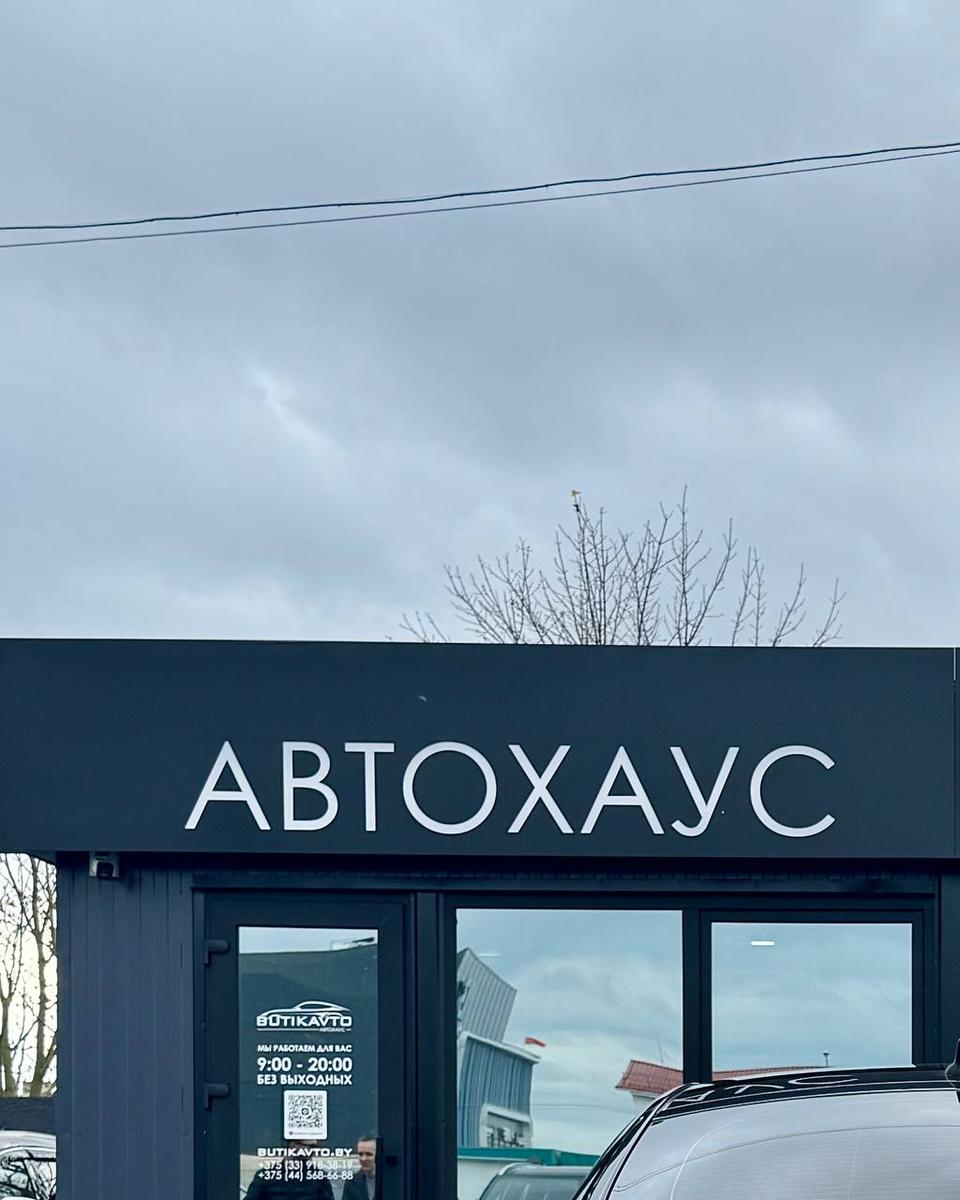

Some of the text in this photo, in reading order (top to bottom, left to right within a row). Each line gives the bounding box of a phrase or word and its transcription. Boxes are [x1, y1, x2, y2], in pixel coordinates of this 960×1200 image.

[184, 741, 836, 838] АВТОХАУС
[257, 1016, 352, 1027] BUTIKAVTO
[317, 1045, 334, 1053] ДЛЯ
[257, 1057, 292, 1072] 9:00
[307, 1057, 353, 1072] 20:00
[257, 1074, 353, 1086] БЕЗ ВЫХОДНЫХ
[257, 1148, 353, 1157] BUTIKAVTO.BY
[258, 1170, 354, 1182] +375 (44) 568-66-88
